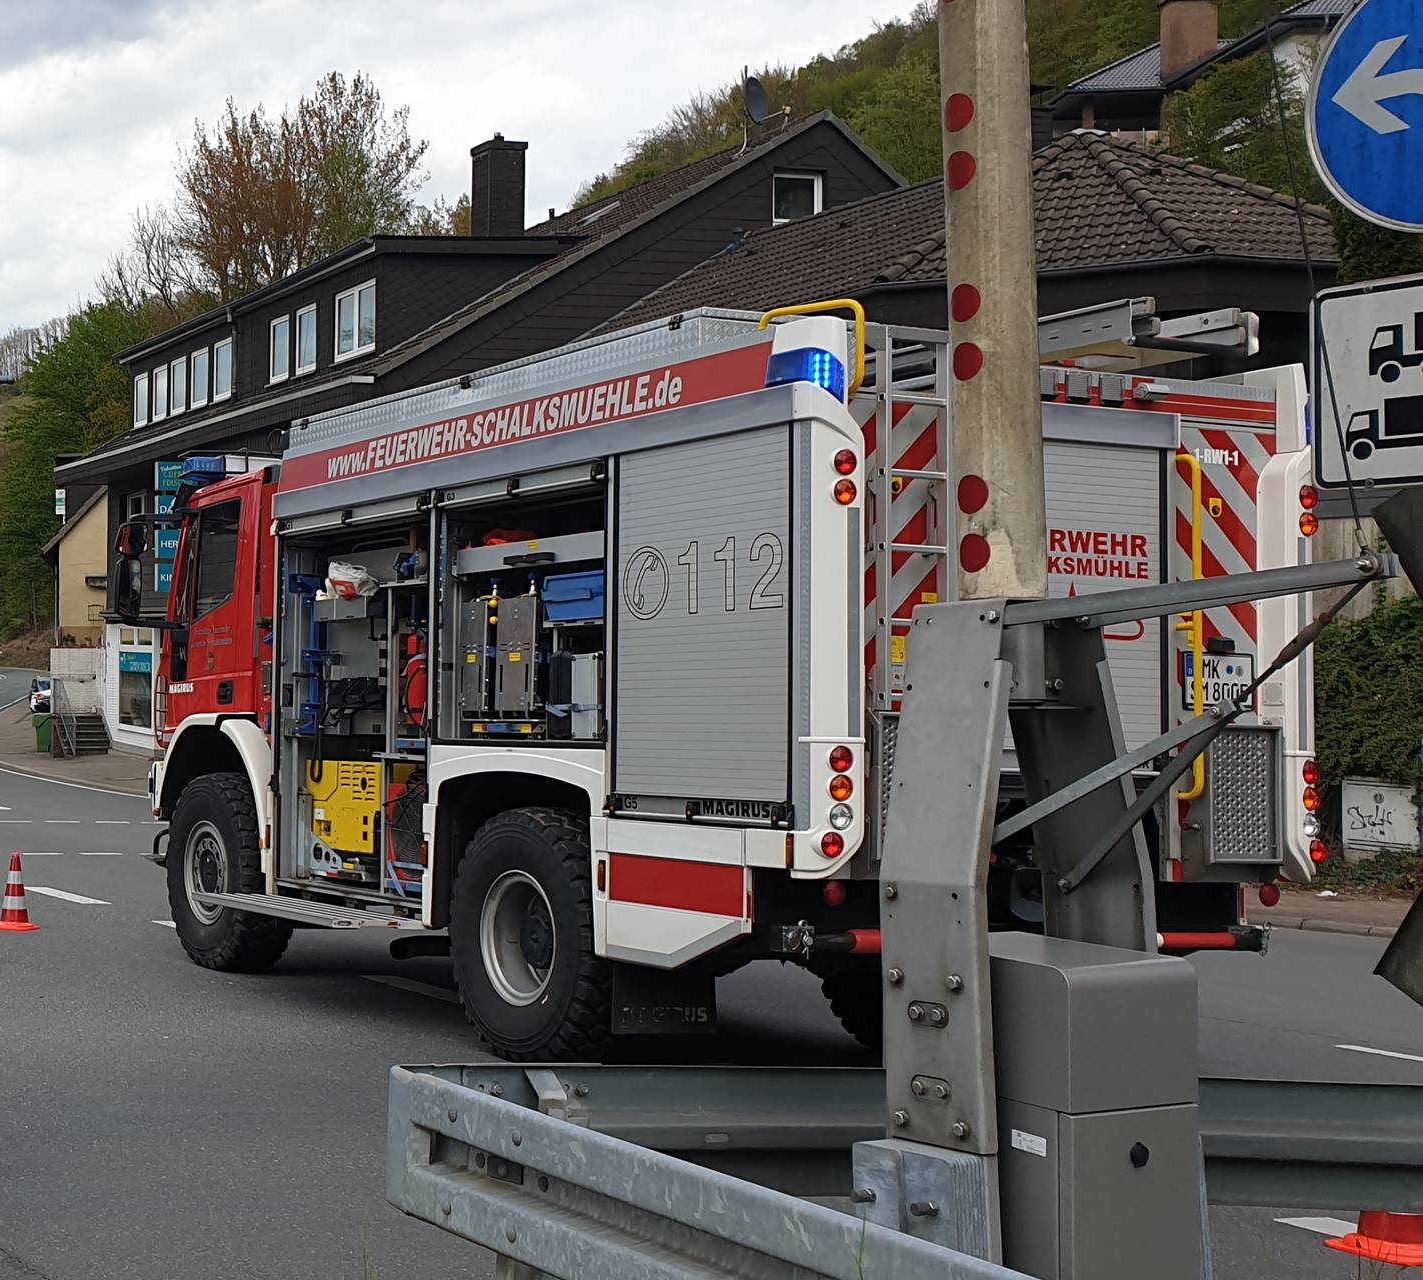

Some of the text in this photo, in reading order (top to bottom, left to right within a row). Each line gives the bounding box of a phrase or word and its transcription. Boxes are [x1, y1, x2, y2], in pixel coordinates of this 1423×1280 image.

[327, 370, 683, 479] www.FEUERWEHR-SCHALKSMUEHLE.de
[678, 532, 784, 614] 112
[1202, 659, 1220, 679] MK
[624, 797, 638, 810] G5
[702, 800, 770, 819] MAGIRUS
